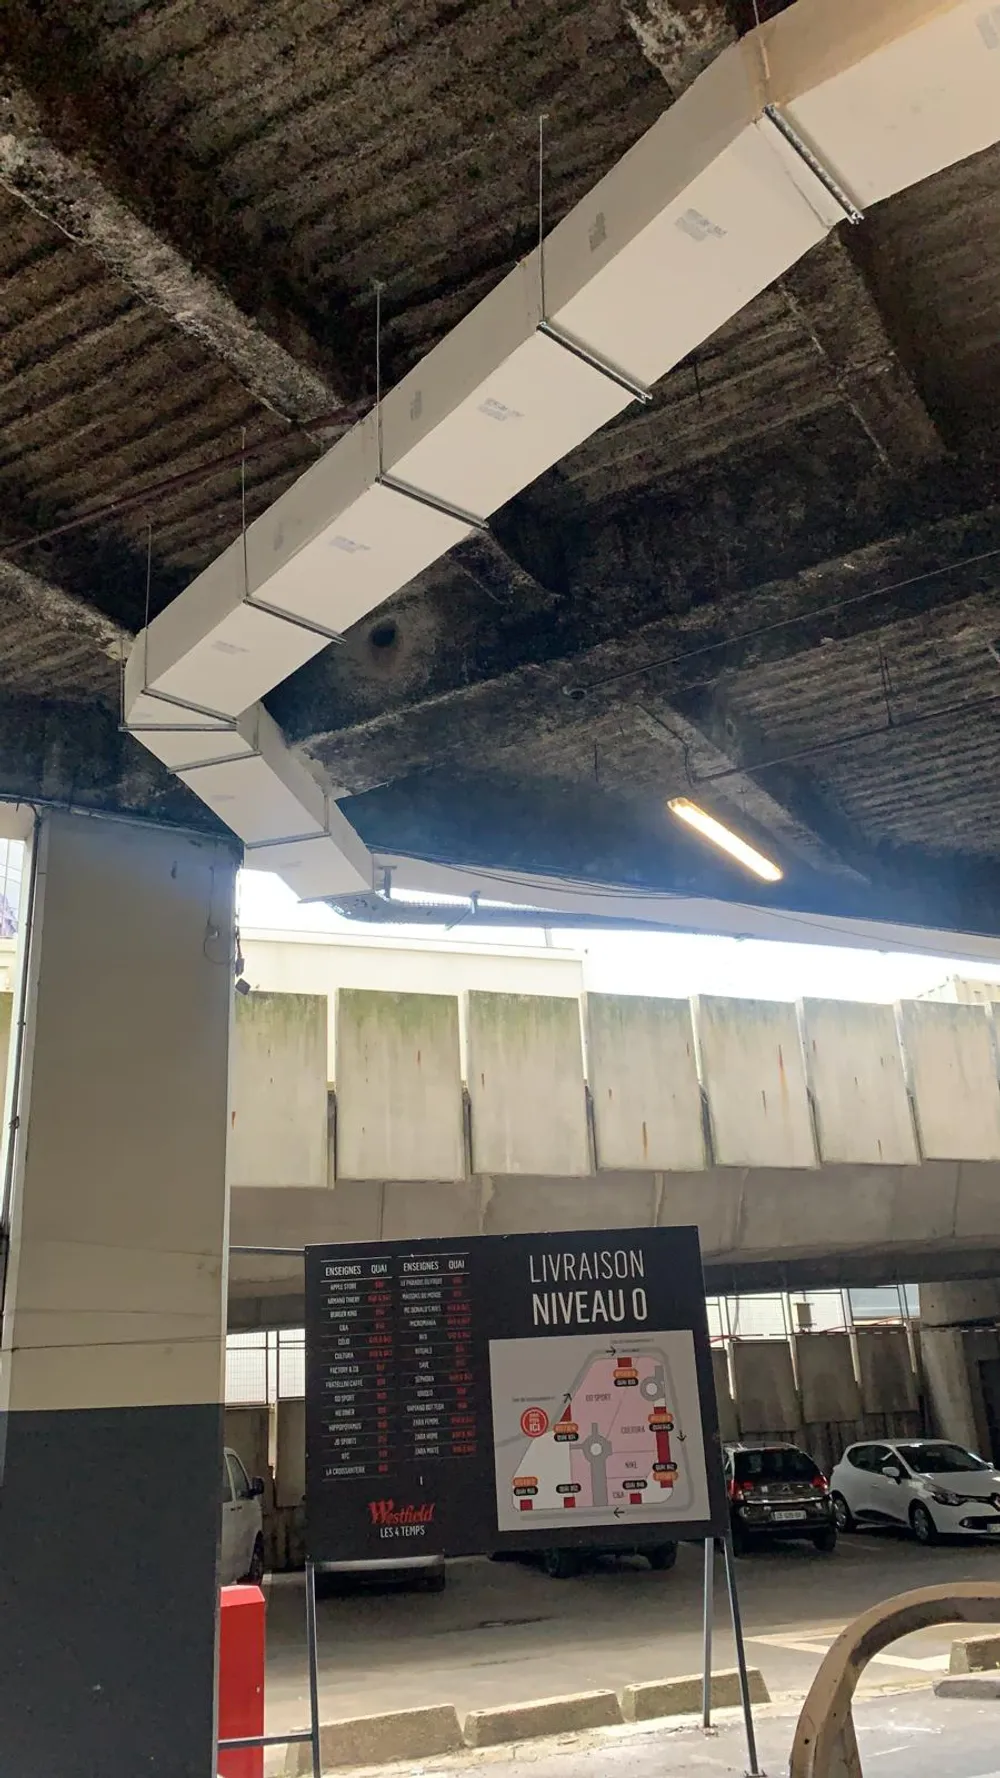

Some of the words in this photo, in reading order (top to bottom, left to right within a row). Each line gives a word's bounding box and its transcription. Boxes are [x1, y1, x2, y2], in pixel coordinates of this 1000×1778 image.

[325, 1265, 362, 1277] ENSEIGNES
[371, 1264, 388, 1274] QUAI
[403, 1260, 439, 1272] ENSEIGNES
[448, 1260, 465, 1270] QUAI
[530, 1250, 644, 1283] LIVRAISON
[532, 1289, 626, 1326] NIVEAU
[334, 1352, 354, 1360] CULTURA
[621, 1426, 645, 1434] CULTURA
[368, 1498, 435, 1525] Westfield
[380, 1527, 394, 1538] LES
[394, 1527, 400, 1537] 4
[400, 1525, 426, 1537] TEMPS
